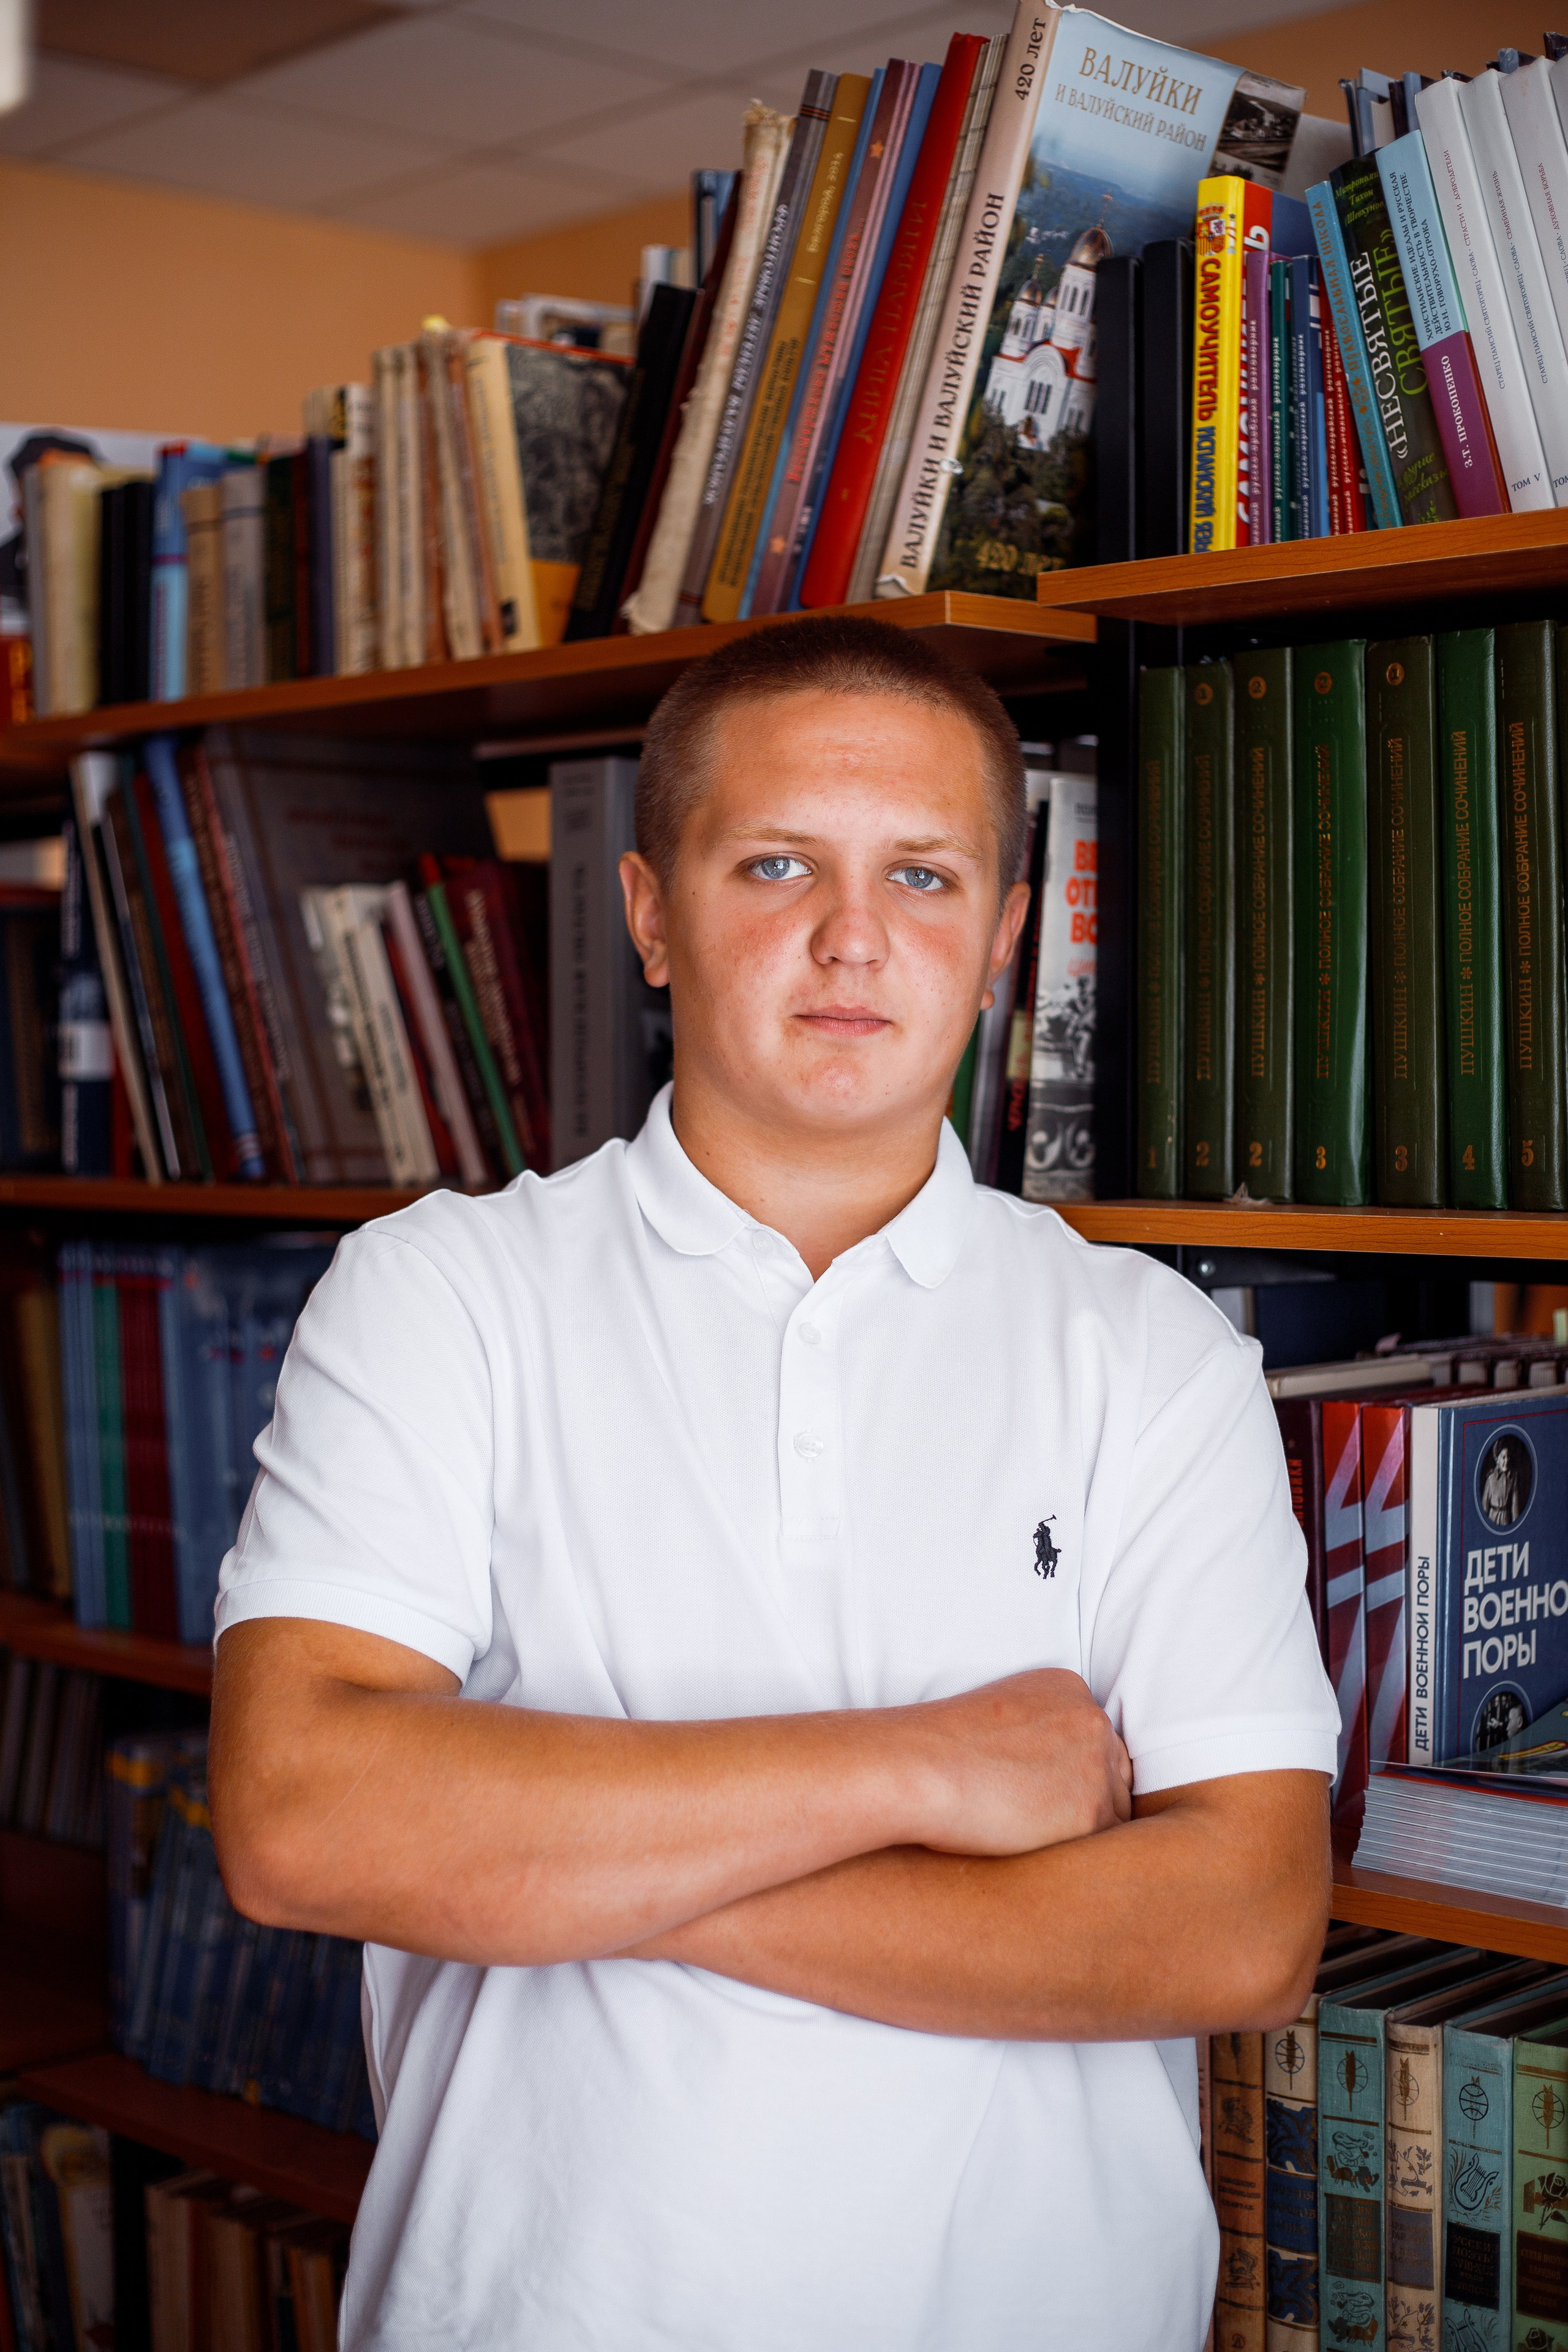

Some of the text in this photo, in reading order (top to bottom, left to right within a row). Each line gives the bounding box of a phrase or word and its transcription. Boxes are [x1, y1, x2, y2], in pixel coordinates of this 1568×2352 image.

[1016, 17, 1047, 102] 420 лет
[1079, 47, 1205, 115] ВАЛУЙКИ
[1055, 83, 1207, 152] И ВАЛУЙСКИЙ РАЙОН
[1335, 172, 1378, 198] Митрополи
[1349, 189, 1373, 206] Тихон
[1389, 172, 1406, 214] РУССКАЯ
[1400, 172, 1419, 232] ТВОРЧЕСТВЕ
[1443, 150, 1461, 200] ДОБРОДЕТЕЛИ
[1537, 162, 1549, 189] БОРЬБА
[1458, 213, 1473, 246] СТРАСТИ
[1545, 188, 1560, 230] ДУХОВНАЯ
[1403, 223, 1415, 257] ИДЕАЛЫ
[1468, 251, 1479, 276] СЛОВА
[1556, 236, 1566, 261] СЛОВА
[1311, 202, 1359, 371] ПРАВОСЛАВНАЯ ШКОЛА
[1409, 257, 1433, 341] ХРИСТИАНСКИЕ
[1416, 239, 1444, 334] ДЕЙСТВИТЕЛЬНОСТЬ
[1422, 218, 1452, 332] Ю.Н. ГОВОРУХО-ОТРОКА
[1476, 279, 1490, 326] СВЯТОГОРЕЦ
[1492, 171, 1548, 384] СТАРЕЦ ПАИСИЙ СВЯТОГОРЕЦ СЛОВА СЕМЕЙНАЯ ЖИЗНЬ
[1373, 228, 1428, 395] СВЯТЫЕ»
[1250, 320, 1259, 391] разговорник
[1273, 337, 1281, 404] разговорник
[1297, 334, 1307, 395] разговорник
[1324, 330, 1334, 392] разговорник
[1349, 252, 1409, 459] «НЕСВЯТЫЕ
[1484, 326, 1498, 361] ПАИСИЙ
[855, 347, 892, 443] КНИГА
[900, 193, 1005, 569] ВАЛУЙКИ И ВАЛУЙСКИЙ РАЙОН
[1492, 360, 1505, 390] СТАРЕЦ
[1193, 257, 1221, 552] САМОУЧИТЕЛЬ ИСПАНСКИЙ ЯЗЫ
[1441, 355, 1473, 469] З.Т. ПРОКОПЕНКО
[1511, 473, 1541, 492] ТОМ V
[1553, 475, 1568, 489] ТОМ
[1251, 502, 1260, 545] менный
[1252, 747, 1265, 1077] ПУШКИН ПОЛНОЕ СОБРАНИЕ СОЧИНЕНИЙ
[1316, 744, 1332, 1078] ПУШКИН ПОЛНОЕ СОБРАНИЕ СОЧИНЕНИЙ
[1388, 737, 1408, 1077] ПУШКИН ПОЛНОЕ СОБРАНИЕ СОЧИНЕНИЙ
[1451, 730, 1475, 1074] ПУШКИН ПОЛНОЕ СОБРАНИЕ СОЧИНЕНИЙ
[1509, 722, 1532, 1069] ПУШКИН ПОЛНОЕ СОБРАНИЕ СОЧИНЕНИЙ
[1196, 1140, 1210, 1166] 2
[1249, 1141, 1263, 1167] 2
[1315, 1145, 1327, 1170] 3
[1395, 1145, 1408, 1172] 3
[1461, 1144, 1476, 1171] 4
[1521, 1139, 1535, 1166] 5
[1464, 1540, 1530, 1596] ДЕТИ
[1463, 1580, 1568, 1634] ВОЕННО
[1415, 1556, 1430, 1752] ДЕТИ ВОЕННОЙ ПОРЫ
[1463, 1629, 1537, 1679] ПОРЫ
